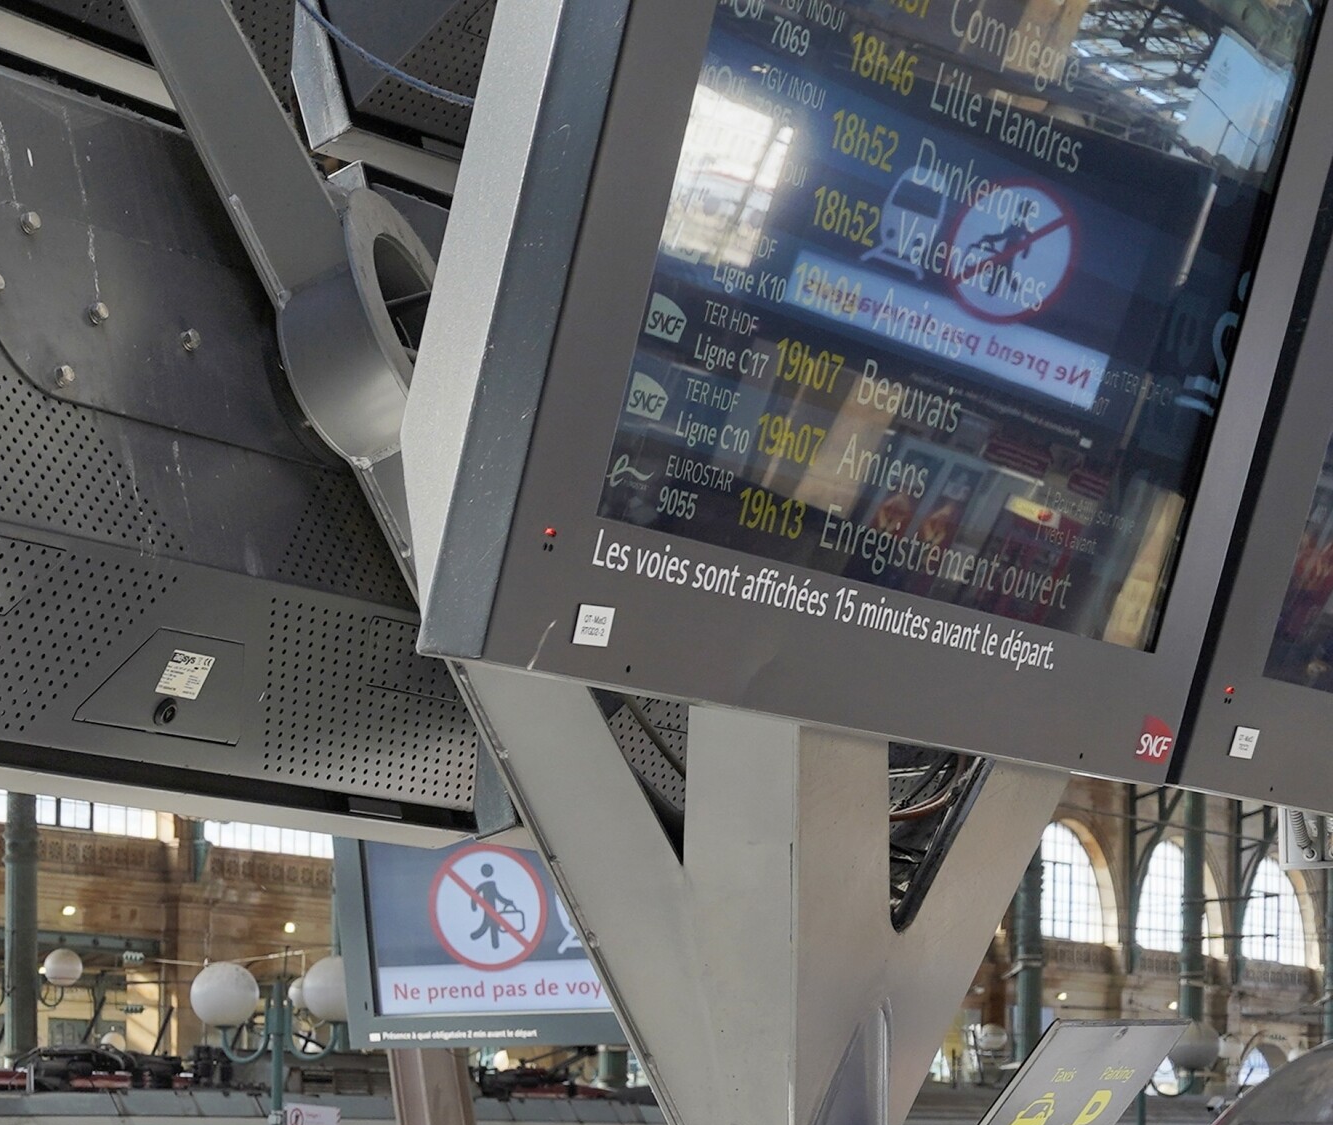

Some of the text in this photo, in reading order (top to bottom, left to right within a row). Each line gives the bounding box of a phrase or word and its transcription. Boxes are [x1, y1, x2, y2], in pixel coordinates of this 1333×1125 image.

[771, 16, 810, 56] 7069
[951, 0, 1080, 92] Compiègne
[760, 63, 827, 111] TGV INOUI
[852, 31, 917, 95] 18h46
[832, 109, 898, 172] 18h52
[930, 62, 1082, 174] Lille Flandres
[911, 138, 1040, 233] Dunkerque
[814, 186, 880, 247] 18h52
[713, 262, 787, 303] Ligne K10
[897, 210, 1046, 312] Valenciennes
[794, 262, 862, 321] 19h04
[647, 310, 684, 334] SNCF
[704, 300, 760, 337] TER HDF
[872, 287, 965, 359] Amiens
[694, 333, 770, 379] Ligne C17
[776, 337, 845, 394] 19h07
[628, 389, 665, 413] SNCF
[684, 378, 741, 412] TER HDF
[857, 359, 962, 434] Beauvais
[675, 410, 750, 455] Ligne C10
[757, 412, 827, 466] 19h07
[665, 454, 734, 492] EUROSTAR
[837, 433, 929, 500] Amiens
[656, 486, 698, 520] 9055
[739, 487, 807, 540] 19h13
[819, 504, 1071, 610] Enregistrement ouvert
[592, 529, 1054, 671] Les voies sont affichées 15 minutes avant le départ.
[1139, 733, 1172, 757] SNCF
[394, 978, 602, 1003] Ne prend pas de voy
[1051, 1065, 1135, 1083] Taxis Parking
